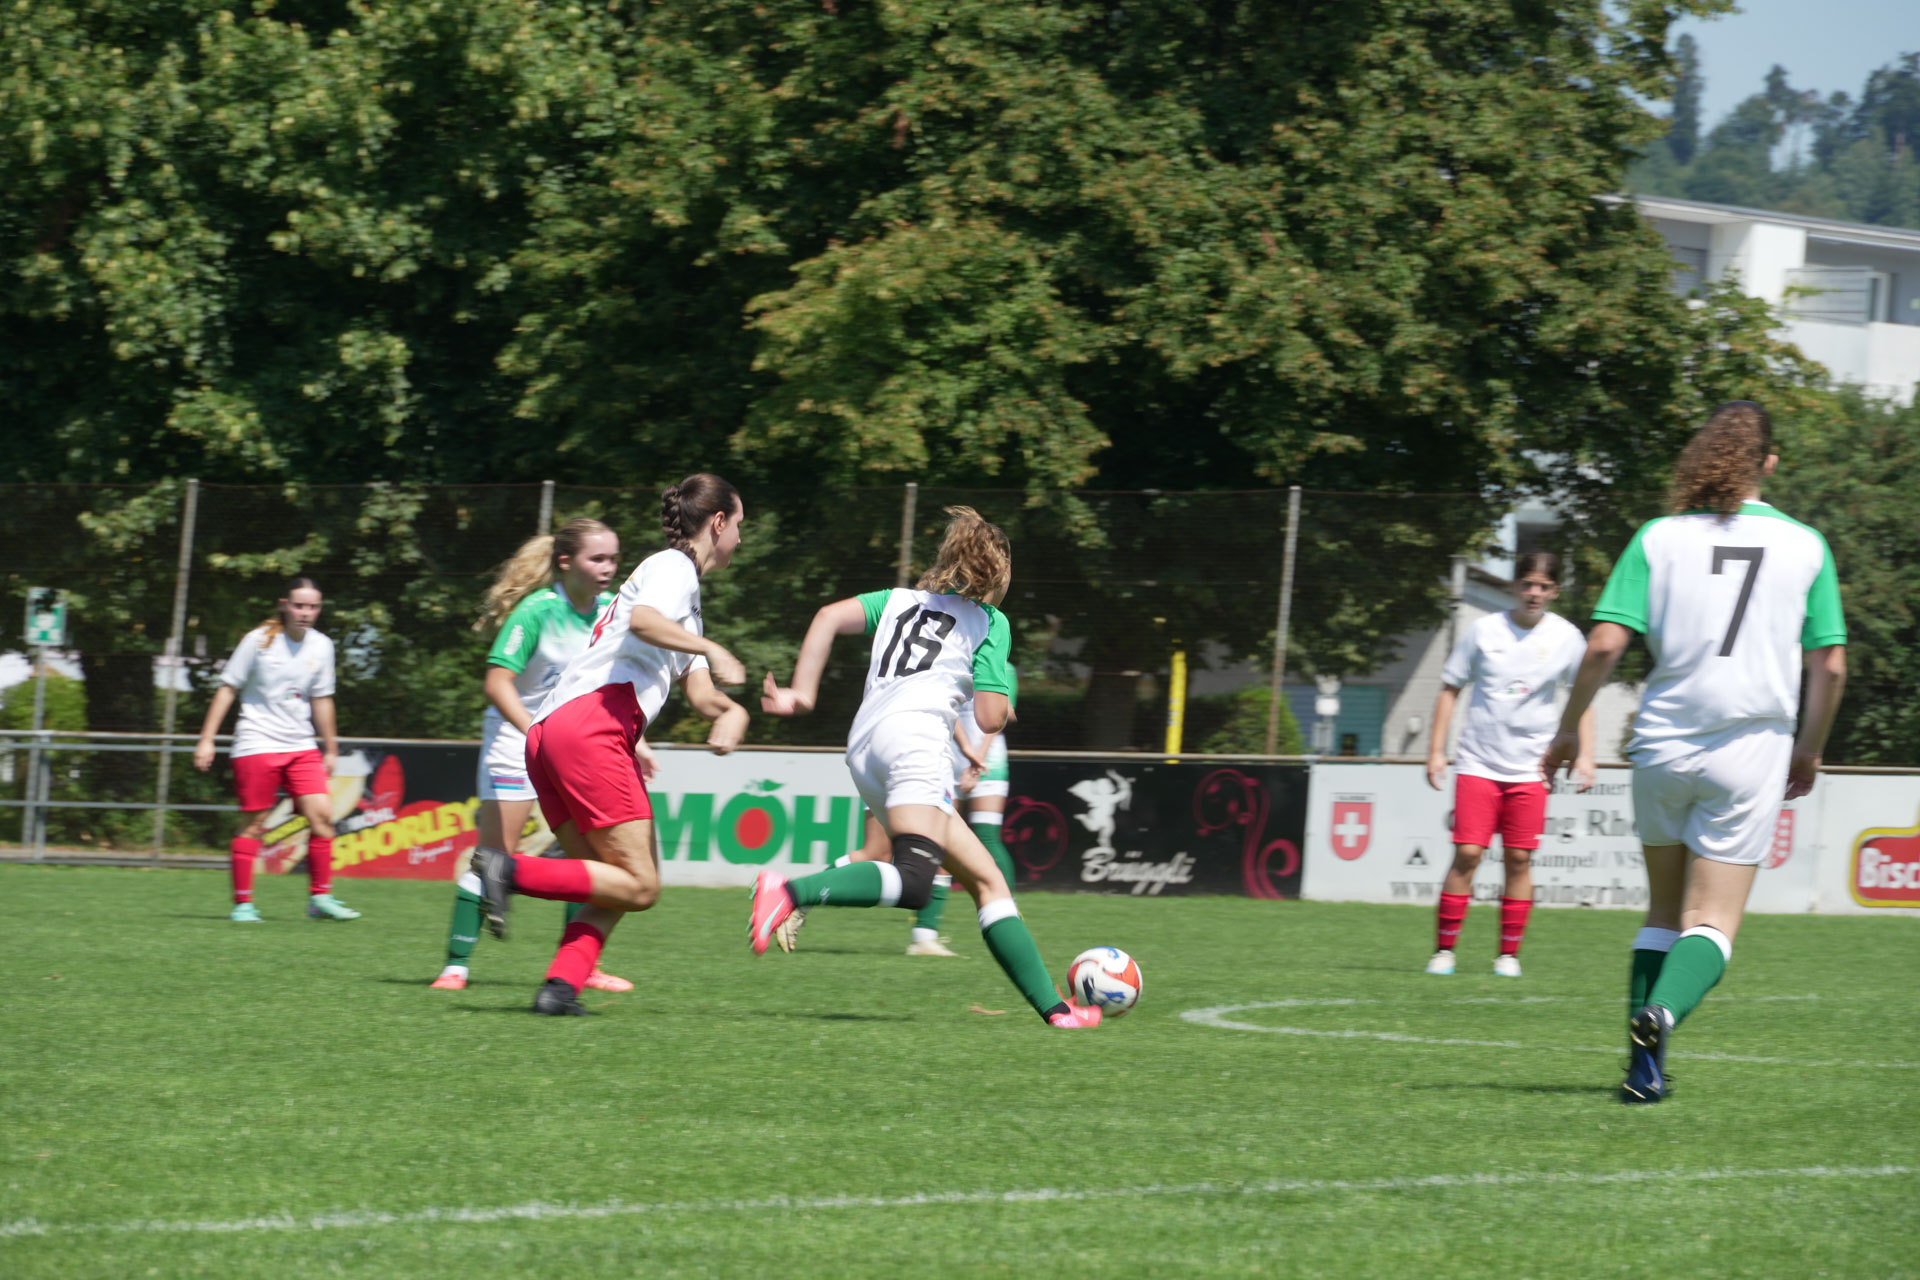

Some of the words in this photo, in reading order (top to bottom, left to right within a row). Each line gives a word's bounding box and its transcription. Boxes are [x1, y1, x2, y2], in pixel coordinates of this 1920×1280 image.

[1711, 546, 1764, 657] 7
[878, 603, 956, 678] 16
[331, 797, 481, 870] SHORLEY
